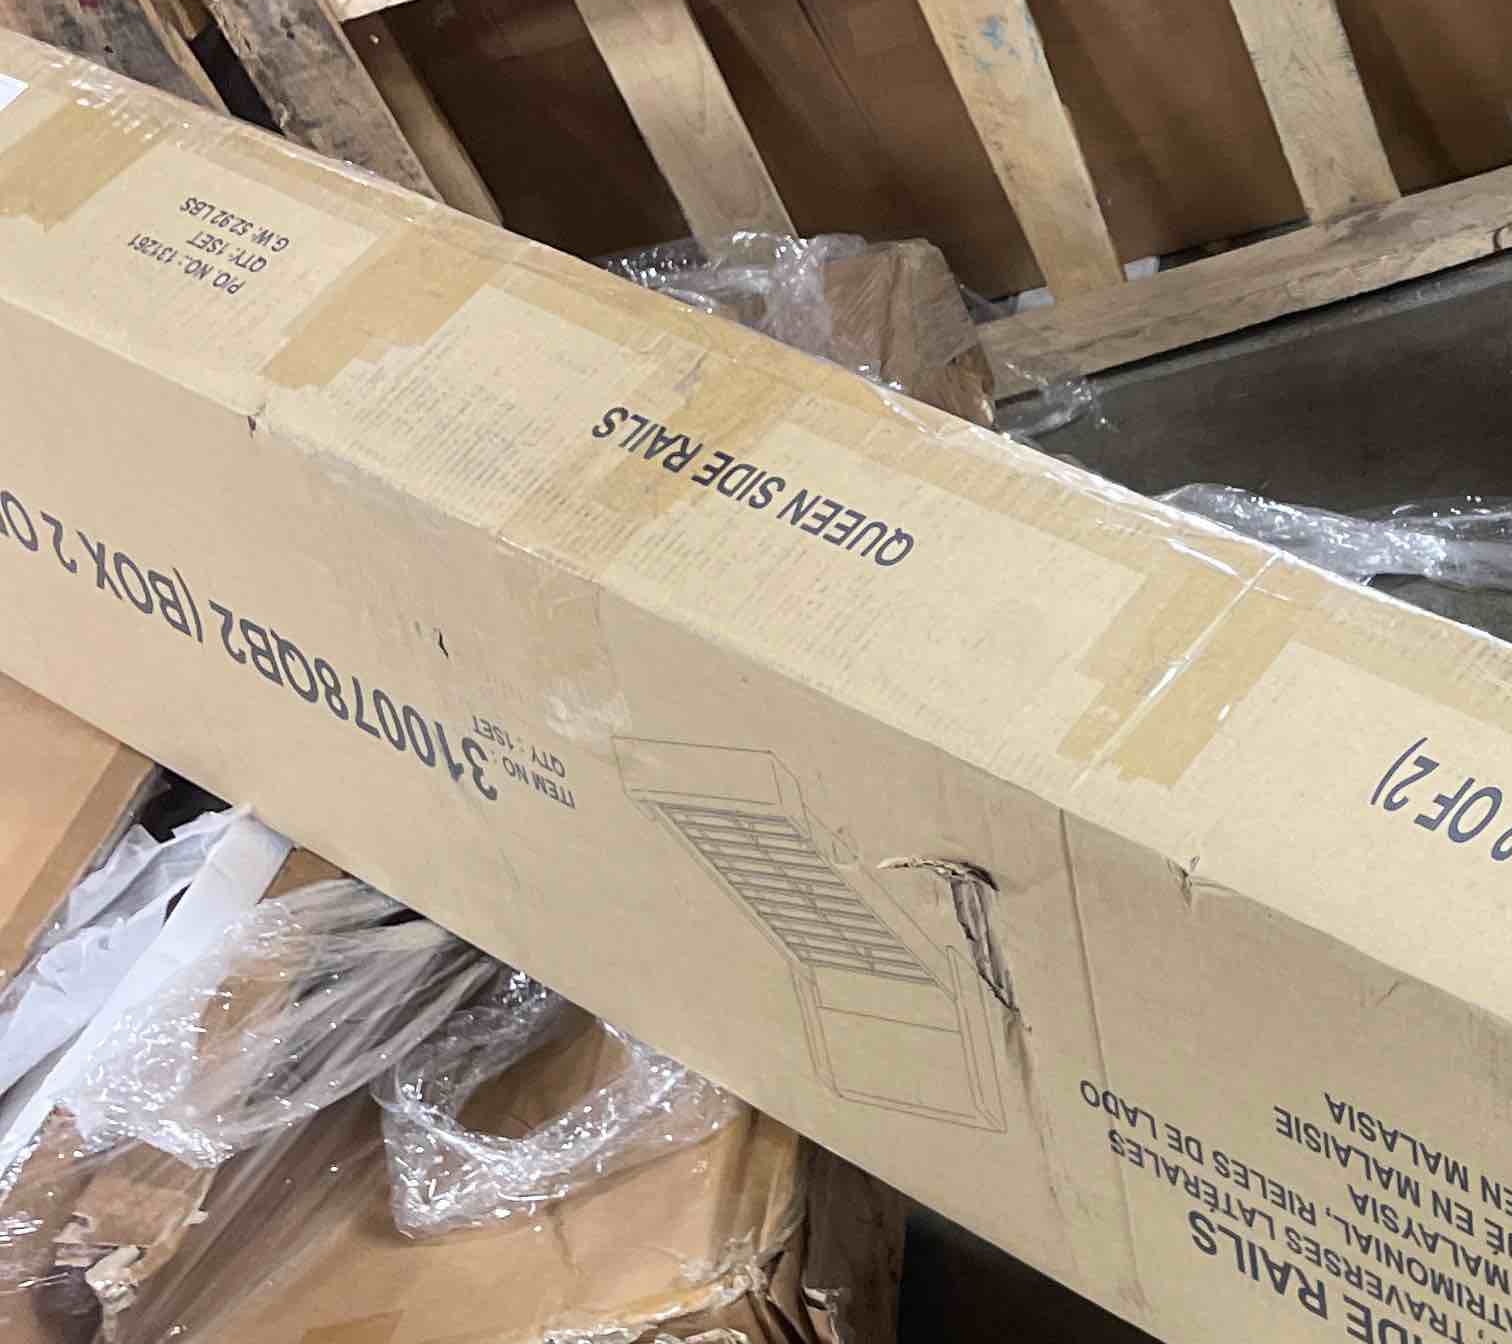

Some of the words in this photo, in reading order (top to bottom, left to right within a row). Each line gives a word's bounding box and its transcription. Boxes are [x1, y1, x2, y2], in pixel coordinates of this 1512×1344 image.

[179, 196, 215, 219] LBS
[185, 231, 228, 256] 1SET
[591, 407, 704, 474] RAILS
[691, 450, 786, 510] SIDE
[0, 491, 39, 552] O
[40, 511, 78, 574] 2
[775, 488, 915, 566] QUEEN
[77, 529, 204, 643] (BOX
[208, 599, 499, 802] 310078QB2
[472, 714, 514, 749] 1SET
[532, 772, 576, 809] ITEM
[1370, 737, 1440, 812] 2)
[1413, 777, 1503, 844] OF
[1079, 1079, 1158, 1140] LADO
[1324, 1092, 1470, 1193] MALASIA
[1166, 1127, 1204, 1165] DE
[1272, 1105, 1421, 1208] MALAISIE
[1107, 1129, 1276, 1241] LATÉRALES
[1211, 1159, 1318, 1225] RIELES
[1432, 1193, 1475, 1236] EN
[1188, 1210, 1328, 1320] RAILS
[1347, 1183, 1510, 1296] MALAYSIA
